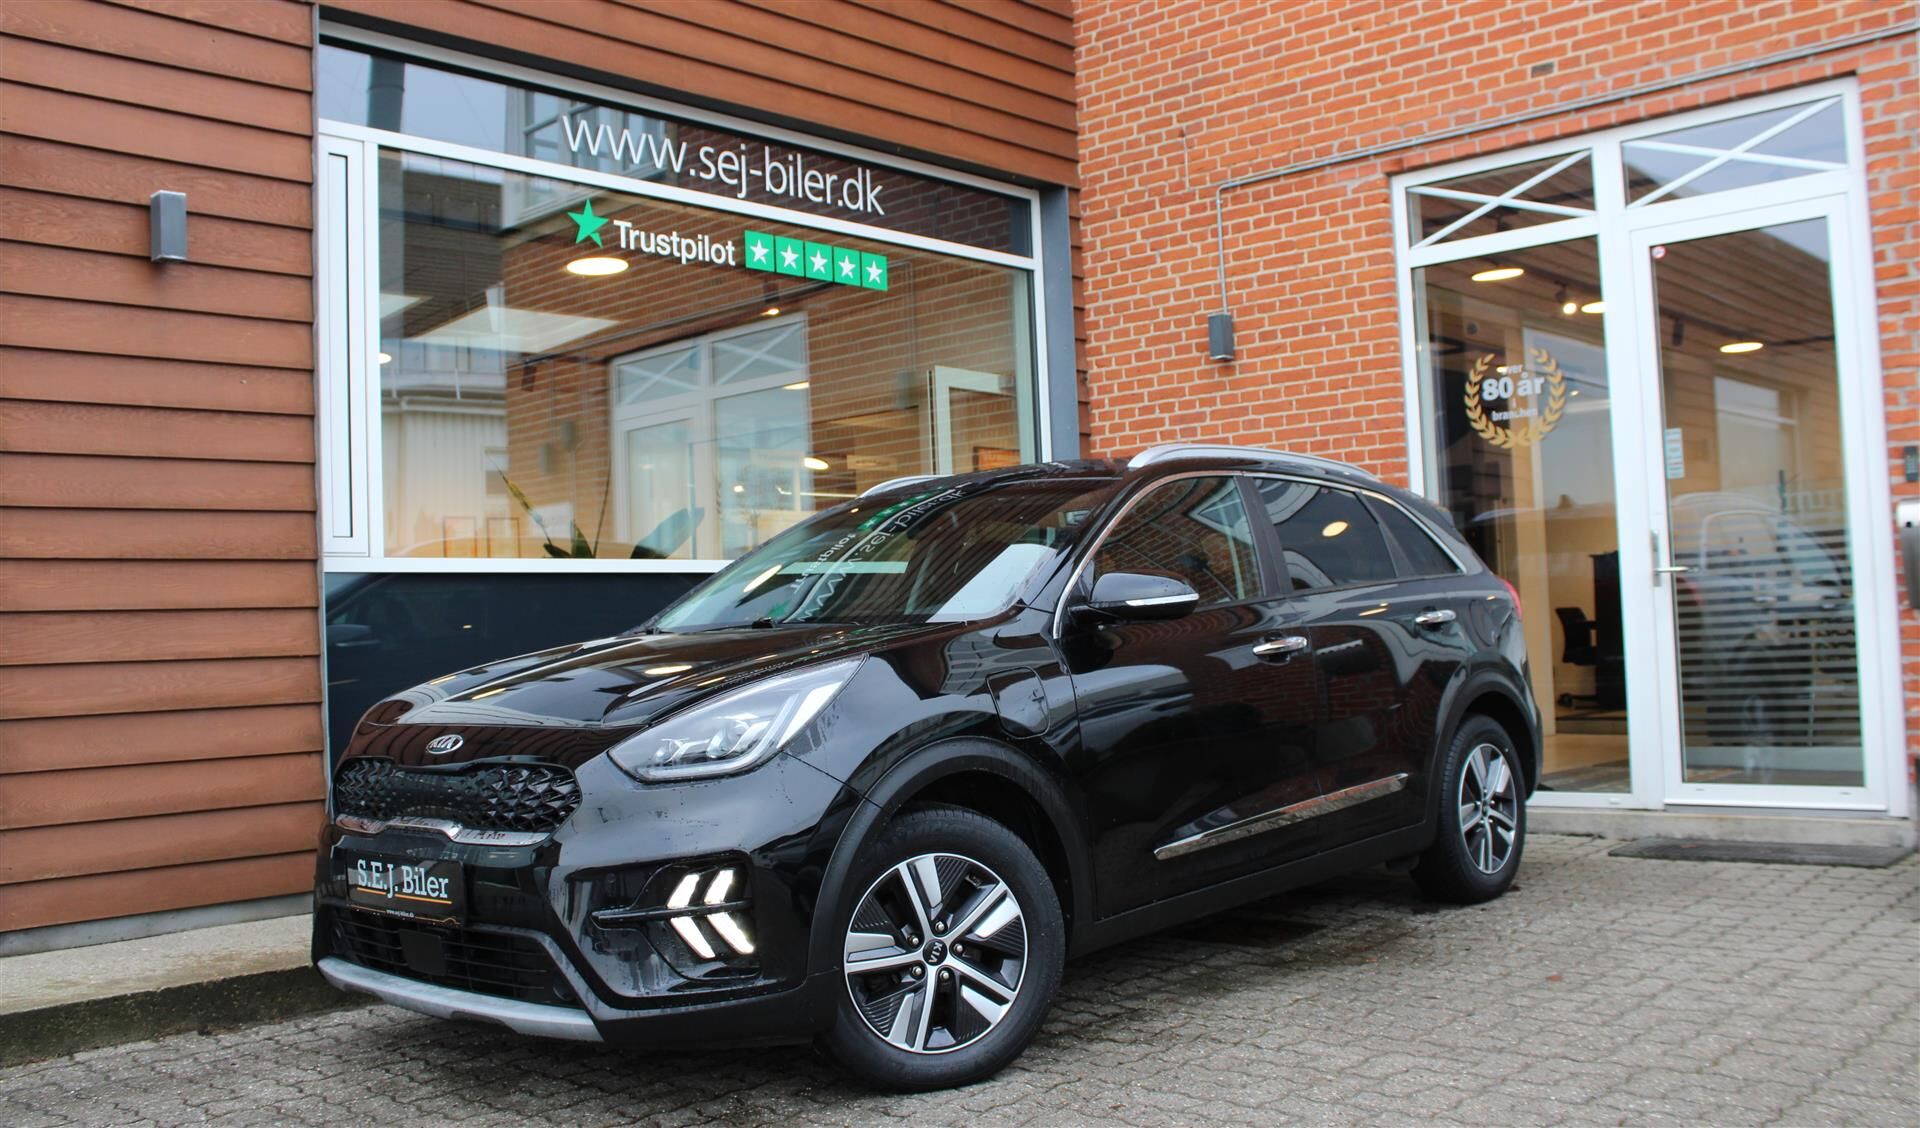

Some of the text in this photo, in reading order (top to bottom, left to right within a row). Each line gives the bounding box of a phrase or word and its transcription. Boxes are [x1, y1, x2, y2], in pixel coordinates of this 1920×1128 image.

[562, 115, 886, 216] www.sej-biler.dk
[613, 219, 737, 267] Trustpilot
[1482, 371, 1544, 401] 80 år
[357, 858, 449, 899] S.E.J. Biler
[928, 942, 943, 963] KIA
